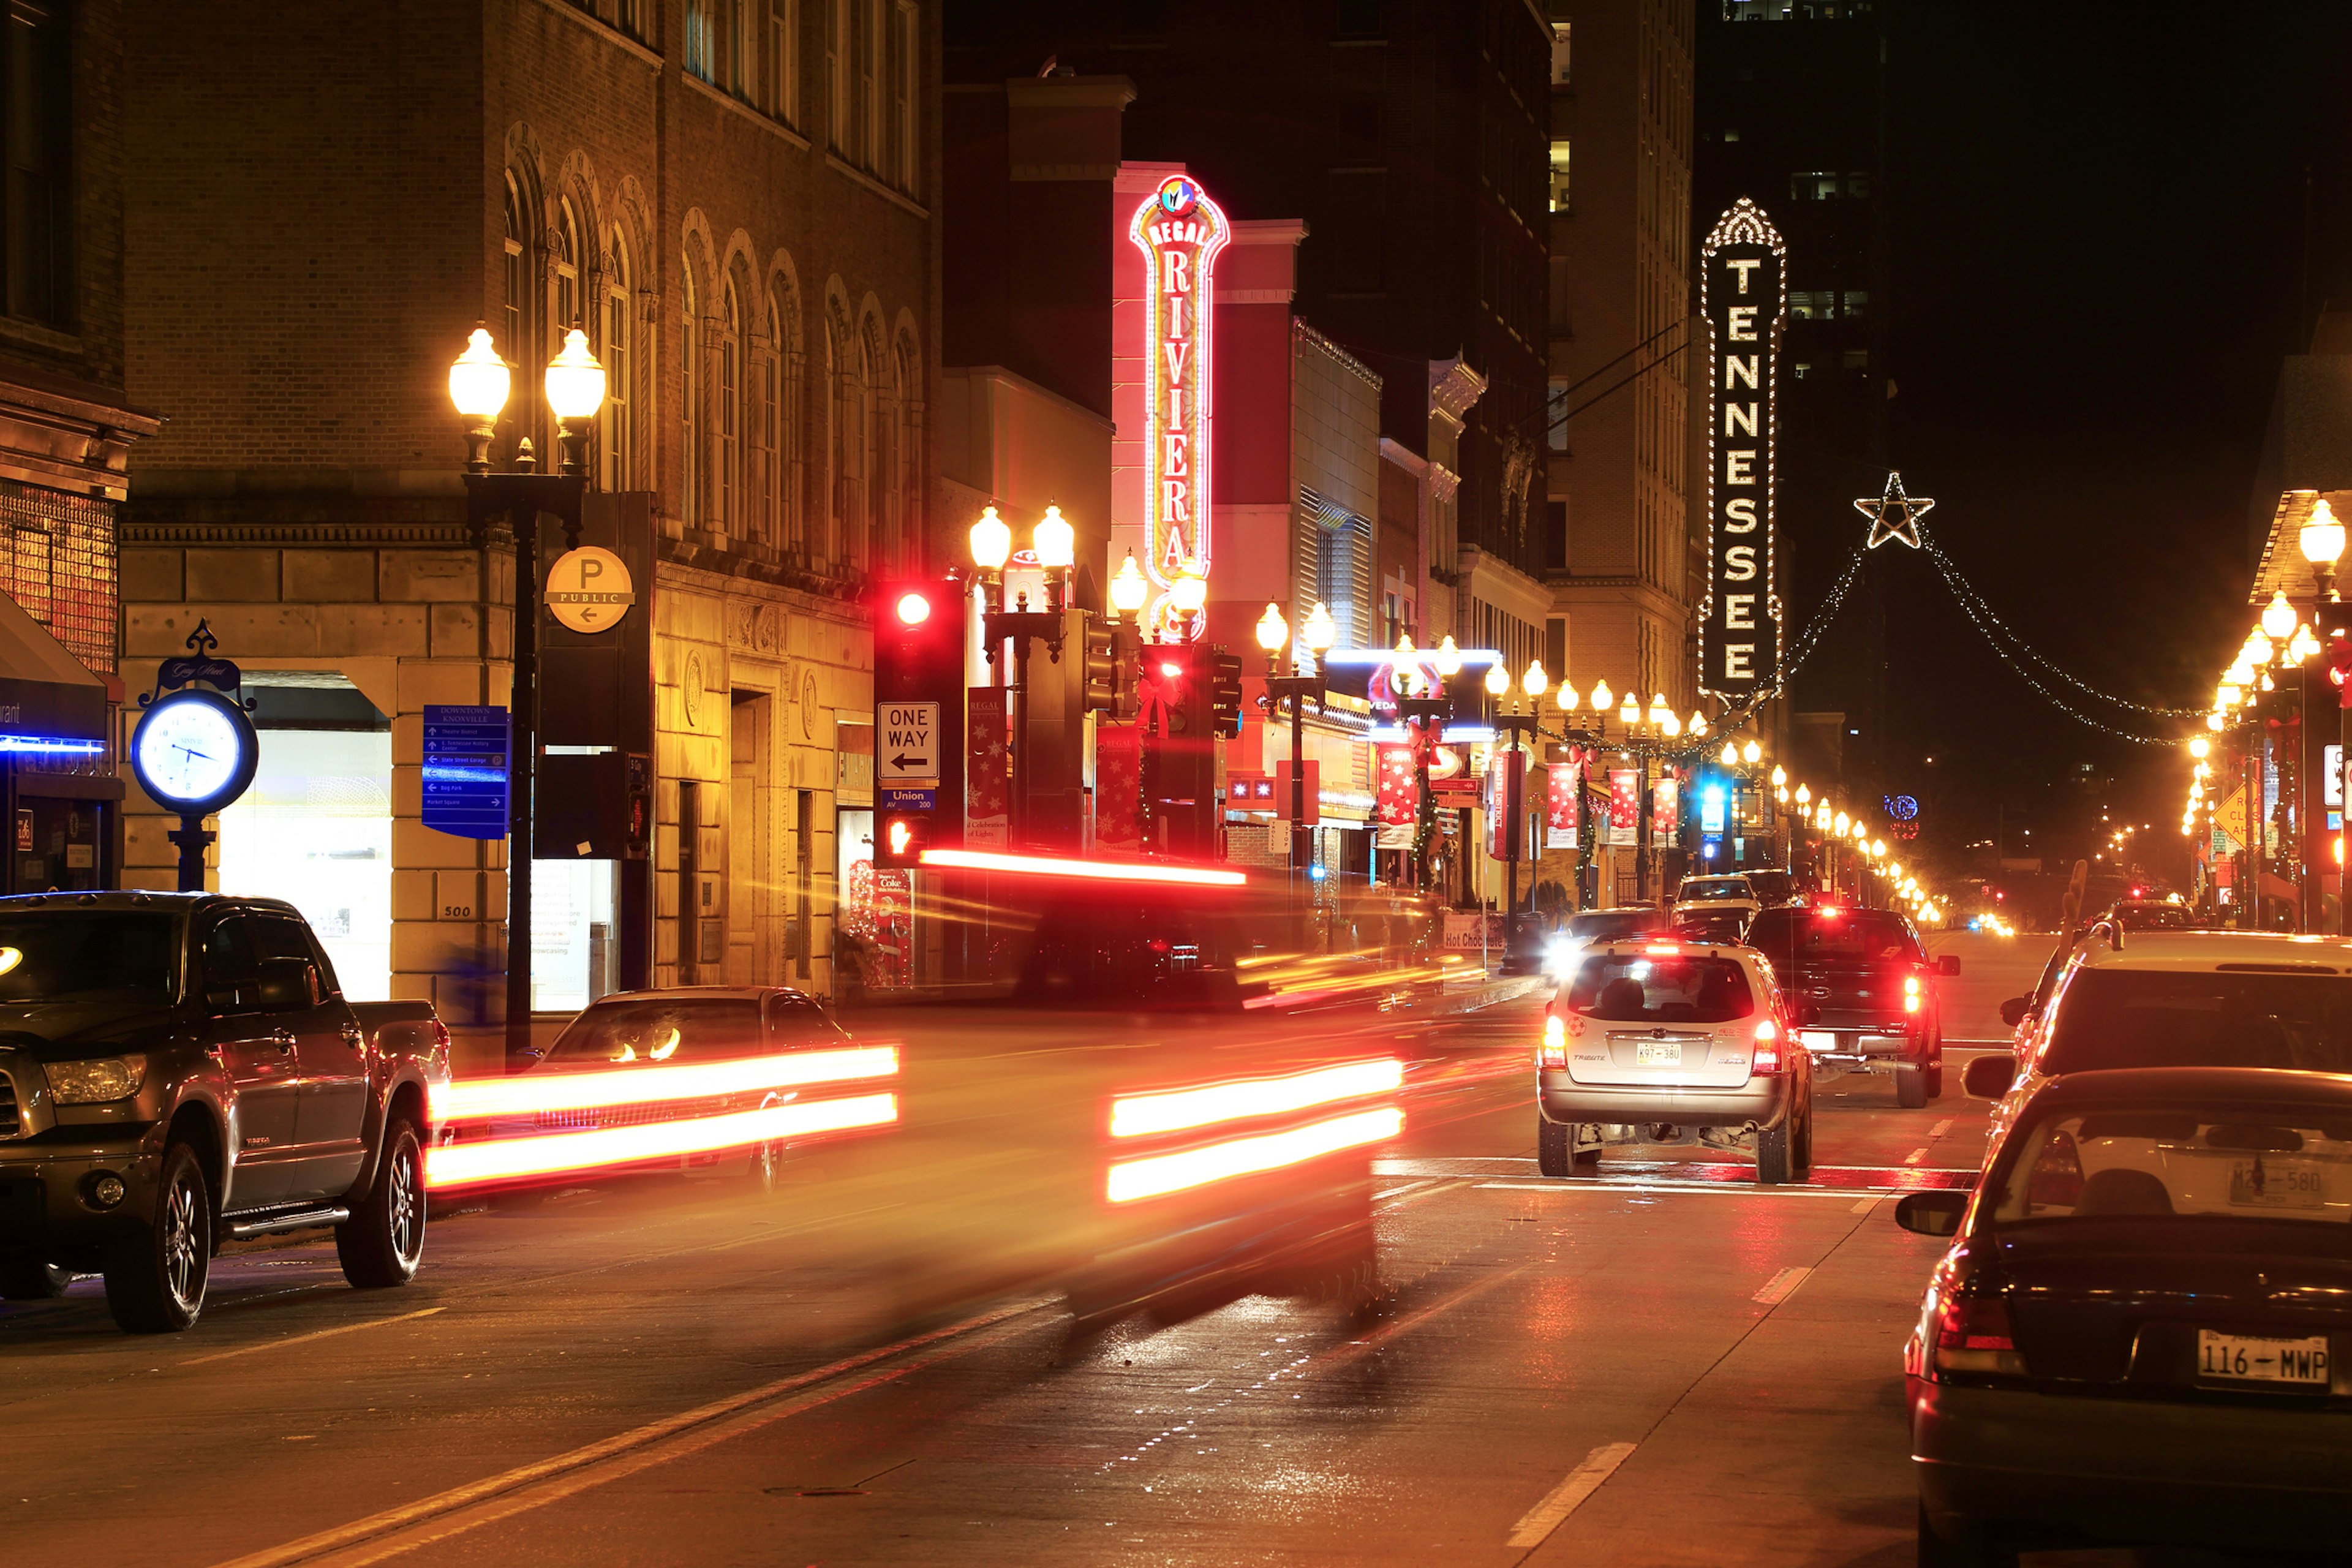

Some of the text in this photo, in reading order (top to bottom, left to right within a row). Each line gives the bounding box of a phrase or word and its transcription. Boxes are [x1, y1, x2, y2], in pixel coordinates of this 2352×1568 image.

[1148, 221, 1207, 247] REGAL
[1163, 251, 1191, 568] RIVIERA
[1724, 258, 1762, 680] TENNESSEE
[581, 559, 603, 589] P
[560, 593, 619, 603] PUBLIC
[890, 709, 928, 726] ONE
[889, 731, 929, 747] WAY
[1495, 757, 1504, 792] THEATRE
[892, 791, 925, 801] Union
[445, 907, 471, 917] 500
[1446, 932, 1502, 947] Hot Choclate
